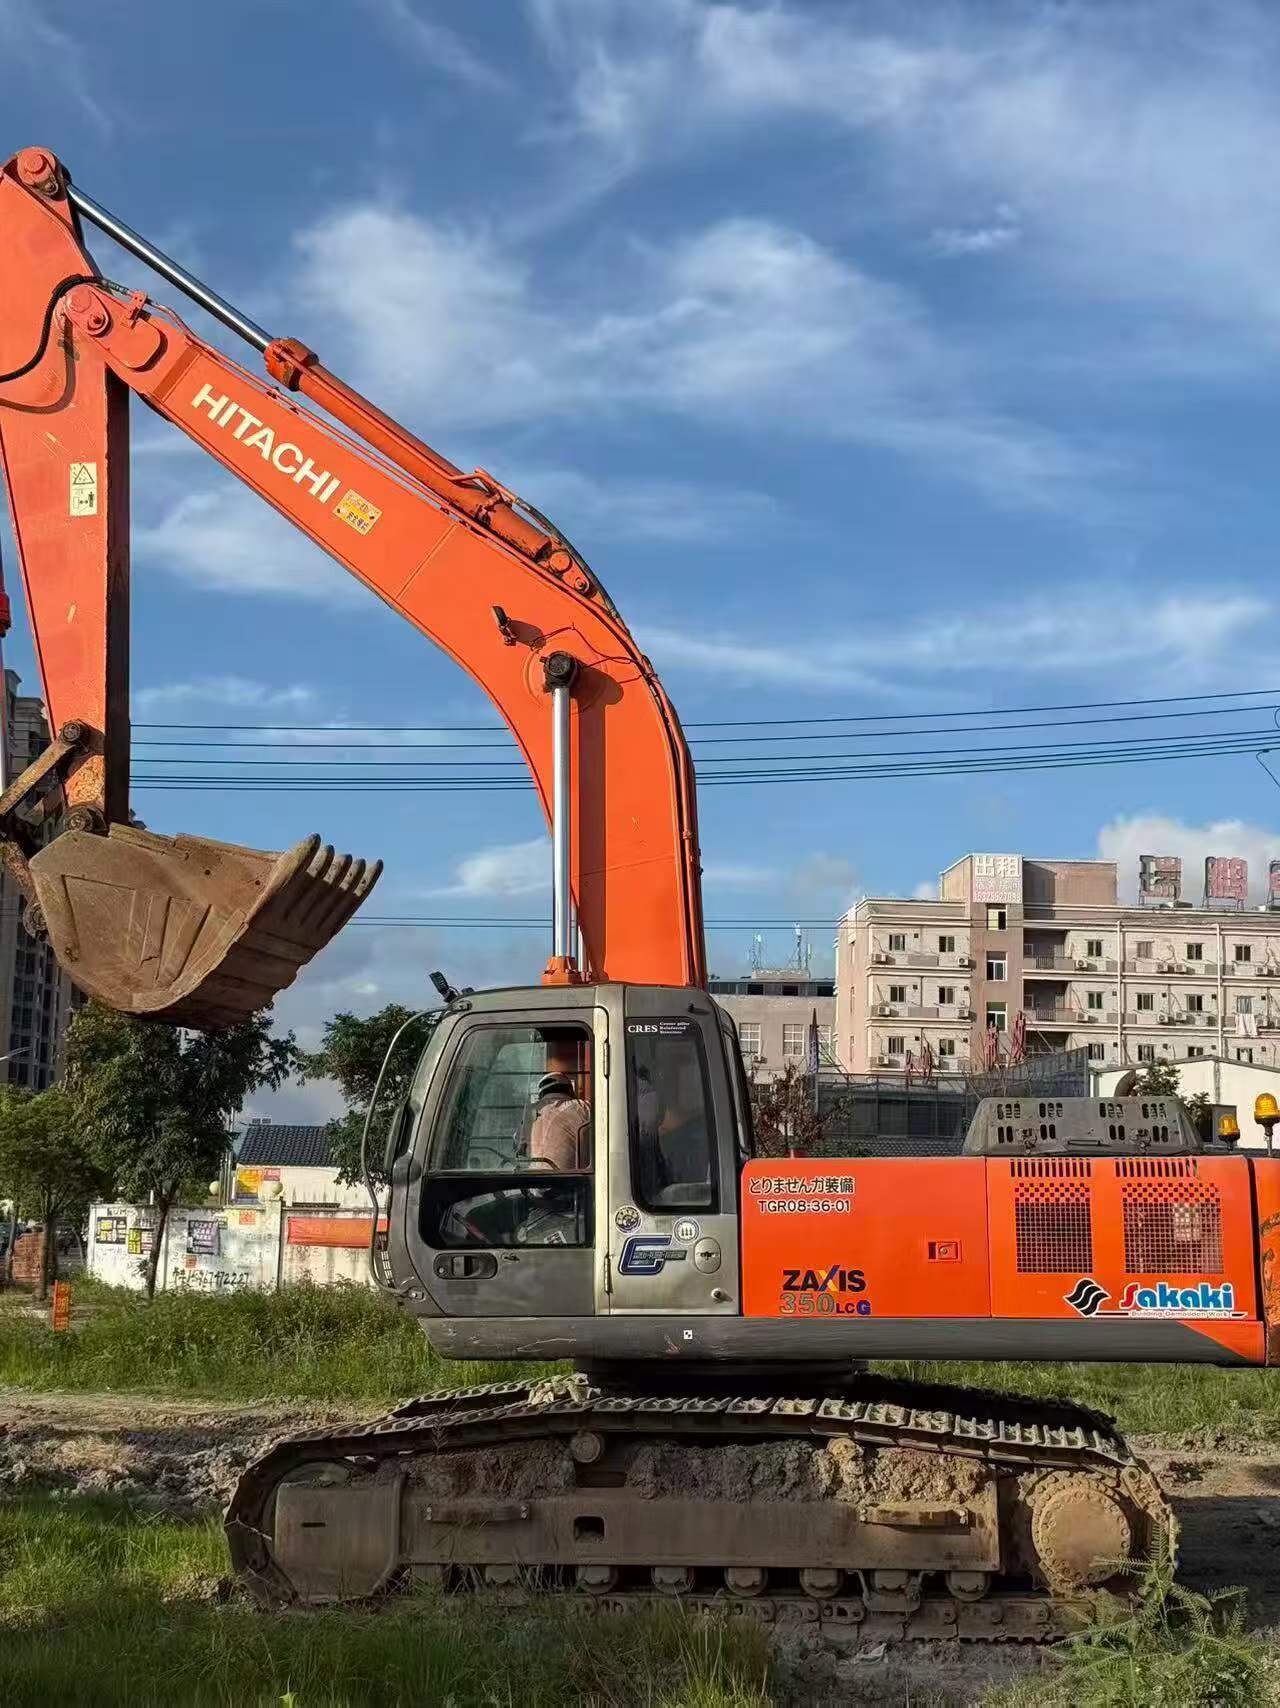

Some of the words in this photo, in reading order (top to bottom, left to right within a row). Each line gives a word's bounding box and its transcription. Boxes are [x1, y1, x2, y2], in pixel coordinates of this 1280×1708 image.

[191, 383, 342, 504] HITACHI
[976, 856, 1021, 878] 出租
[627, 1024, 658, 1033] CRES
[758, 1200, 850, 1212] TGR08-36-01
[783, 1265, 867, 1292] ZAXIS
[1120, 1283, 1234, 1309] Sakaki
